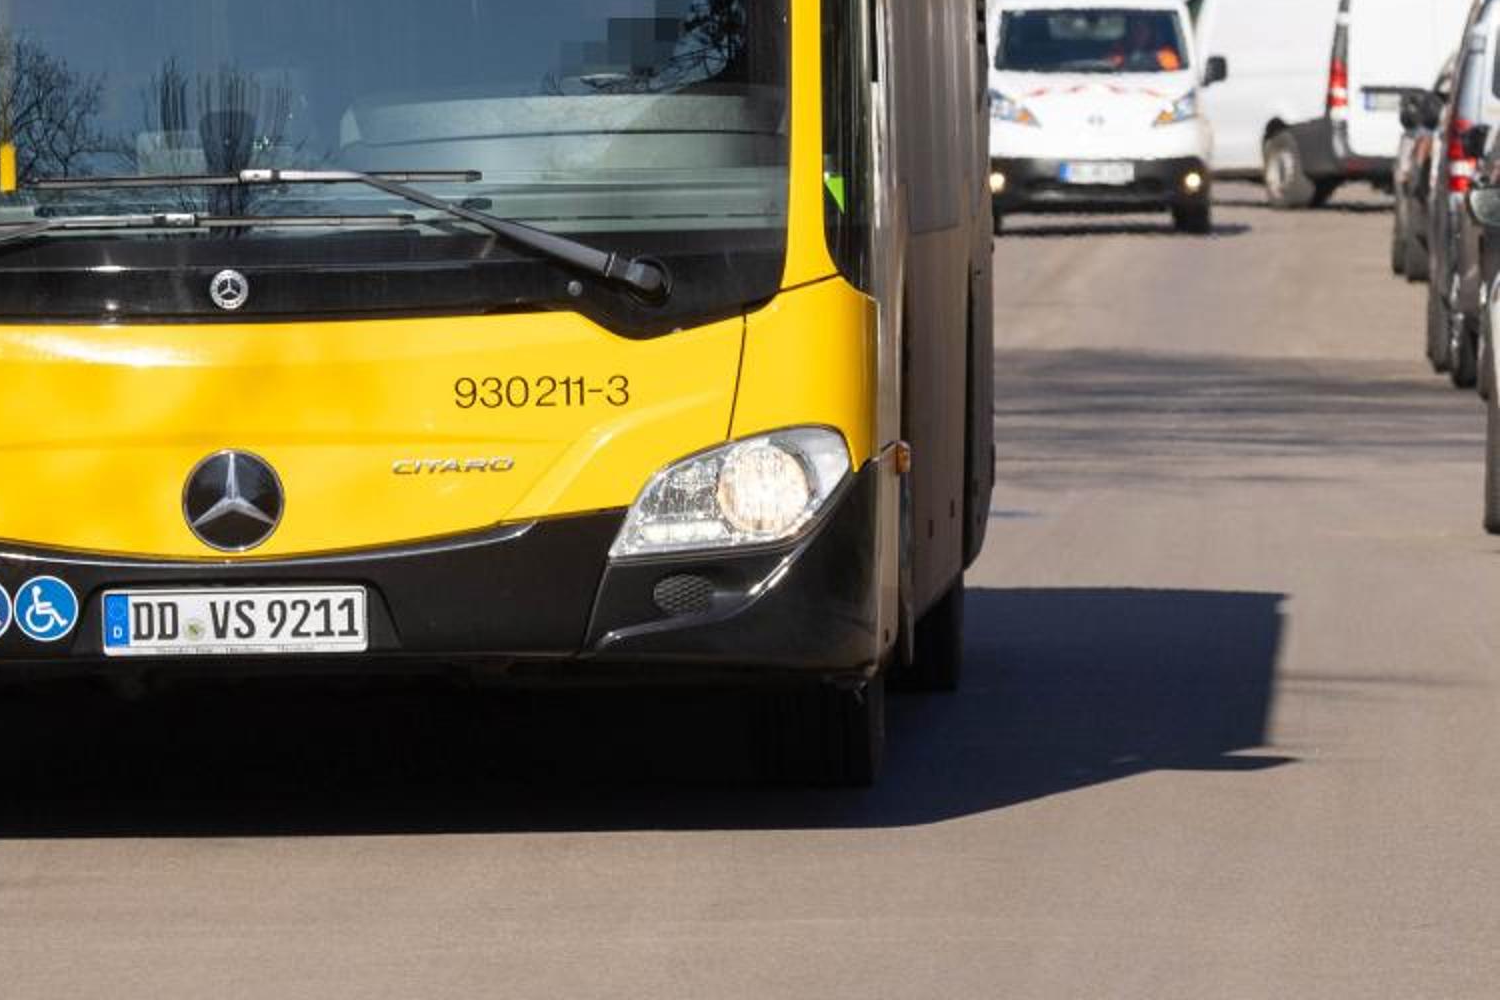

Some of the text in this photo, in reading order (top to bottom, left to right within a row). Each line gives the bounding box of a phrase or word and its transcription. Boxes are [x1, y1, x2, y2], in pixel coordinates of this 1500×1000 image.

[392, 456, 514, 475] CITARO
[133, 598, 358, 640] DD VS 9211
[113, 627, 123, 639] D
